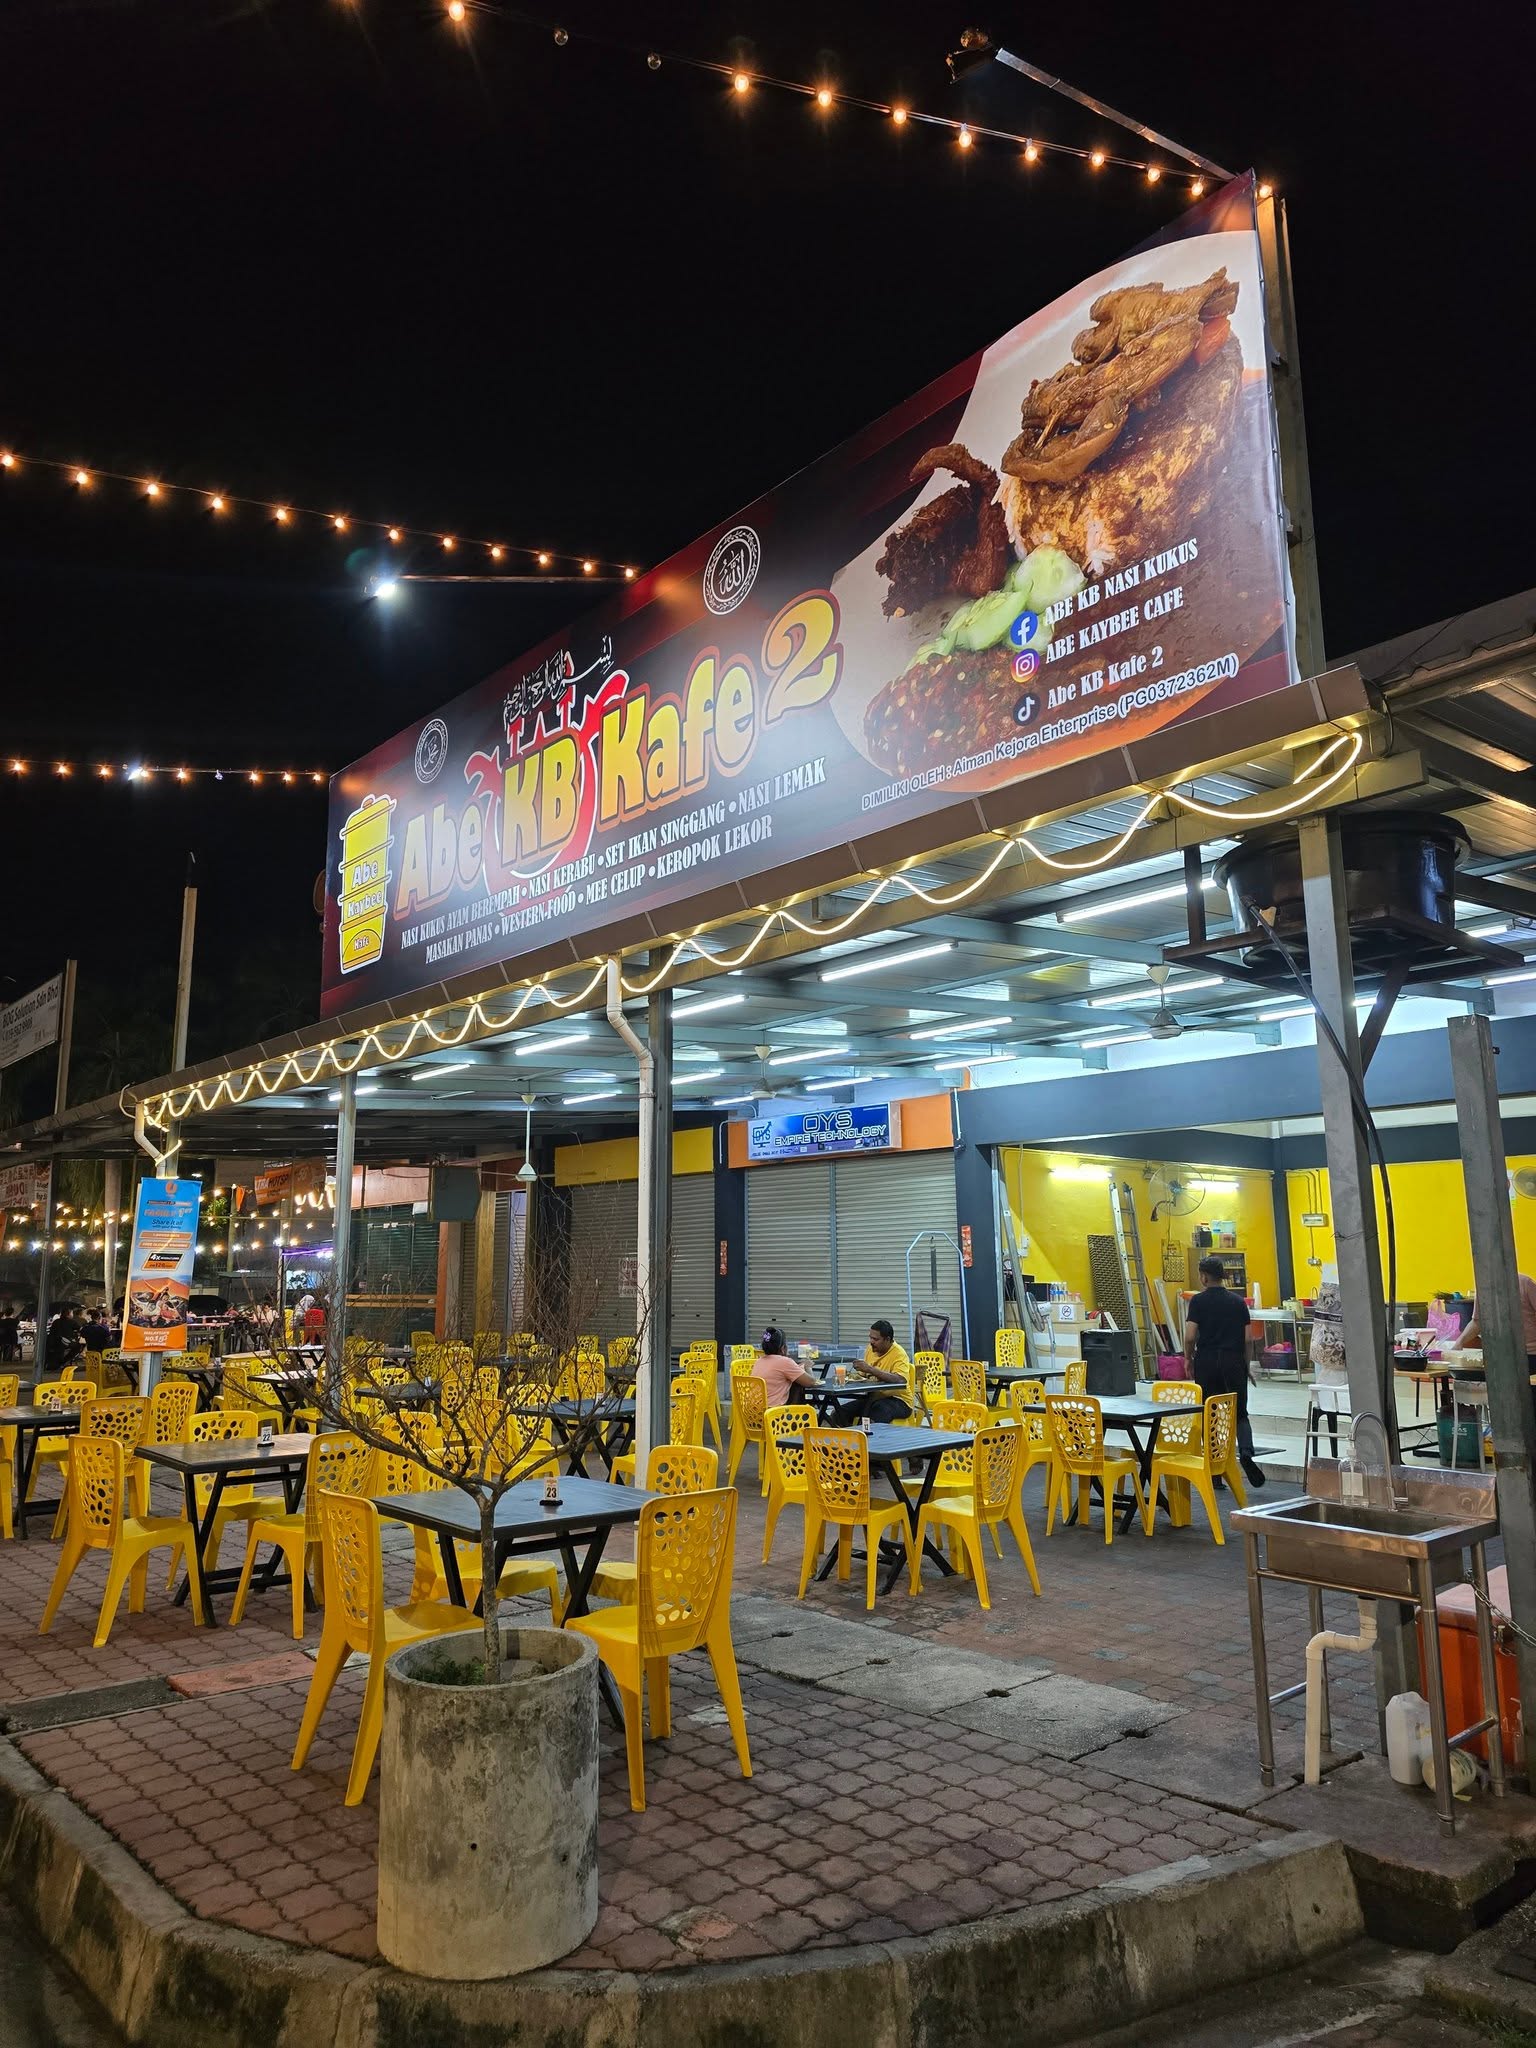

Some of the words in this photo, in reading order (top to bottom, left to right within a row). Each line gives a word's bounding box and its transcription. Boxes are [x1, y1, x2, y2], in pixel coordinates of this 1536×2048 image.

[1044, 595, 1073, 627] ABE
[1077, 584, 1100, 612] KB
[1104, 564, 1140, 598] NASI
[1144, 538, 1199, 582] KUKUS
[1045, 633, 1075, 664] ABE
[1079, 606, 1140, 649] KAYBEE
[1143, 586, 1184, 621] CAFE
[1047, 682, 1076, 709] Abe
[1080, 669, 1104, 697] KB
[1108, 654, 1147, 685] Kafe
[1151, 645, 1164, 669] 2
[394, 797, 485, 920] Abe
[501, 730, 582, 870] KB
[597, 645, 759, 832] Kafe
[761, 589, 845, 727] 2
[861, 781, 910, 811] DIMILIKI
[910, 765, 945, 793] OLEH
[952, 750, 993, 776] Aiman
[994, 732, 1039, 763] Kejora
[1041, 703, 1117, 743] Enterprise
[1117, 653, 1240, 719] (PG0372362M)
[351, 860, 379, 889] Abe
[401, 927, 419, 950] NASI
[419, 915, 445, 943] KUKUS
[446, 908, 469, 933] AYAM
[471, 884, 520, 921] BEREMPAH
[528, 874, 550, 899] NASI
[553, 853, 596, 890] KERABU
[605, 841, 626, 869] SET
[628, 828, 657, 859] IKAN
[660, 800, 725, 847] SINGGANG
[738, 783, 770, 816] NASI
[773, 757, 827, 802] LEMAK
[425, 938, 464, 964] MASAKAN
[465, 922, 493, 950] PANAS
[500, 891, 576, 936] WESTERN-FOOD
[585, 877, 608, 906] MEE
[610, 863, 646, 896] CELUP
[656, 834, 721, 879] KEROPOK
[724, 814, 773, 854] LEKOR
[347, 890, 383, 918] Kaybee
[774, 1134, 810, 1146] EMPIRE
[811, 1124, 887, 1144] TECHNOLOGY
[803, 1110, 853, 1133] OYS
[546, 1486, 557, 1498] 23
